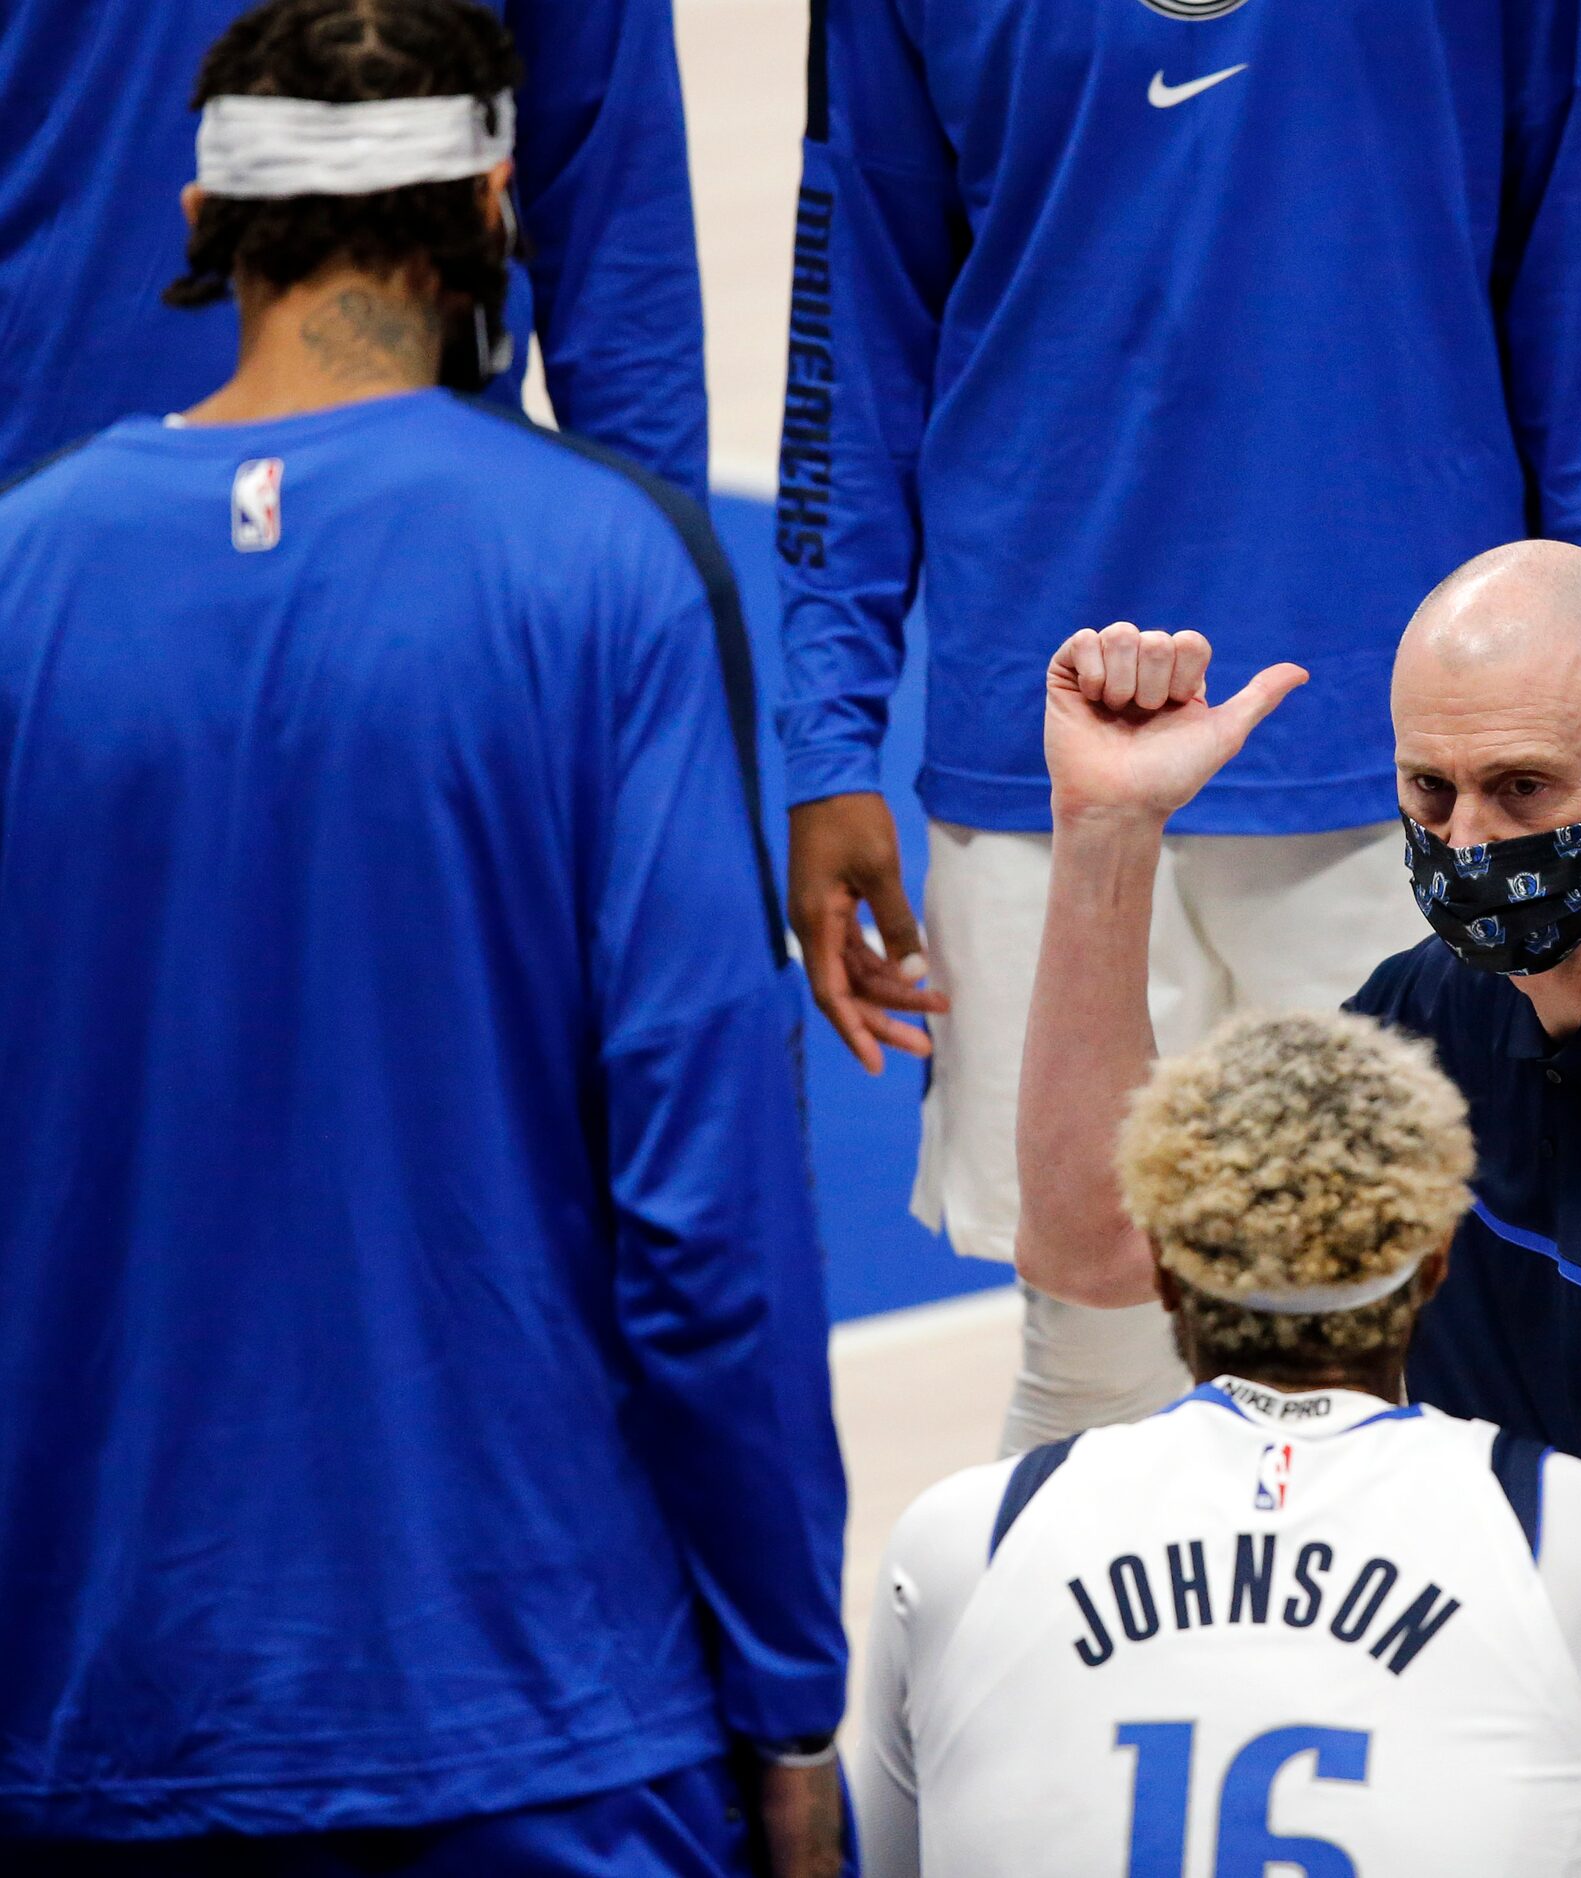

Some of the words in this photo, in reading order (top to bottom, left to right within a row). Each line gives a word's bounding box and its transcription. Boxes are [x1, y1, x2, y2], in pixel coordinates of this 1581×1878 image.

[1223, 1381, 1275, 1418] NIKE
[1279, 1396, 1331, 1420] PRO
[1066, 1533, 1462, 1678] JOHNSON
[1111, 1719, 1374, 1878] 16
